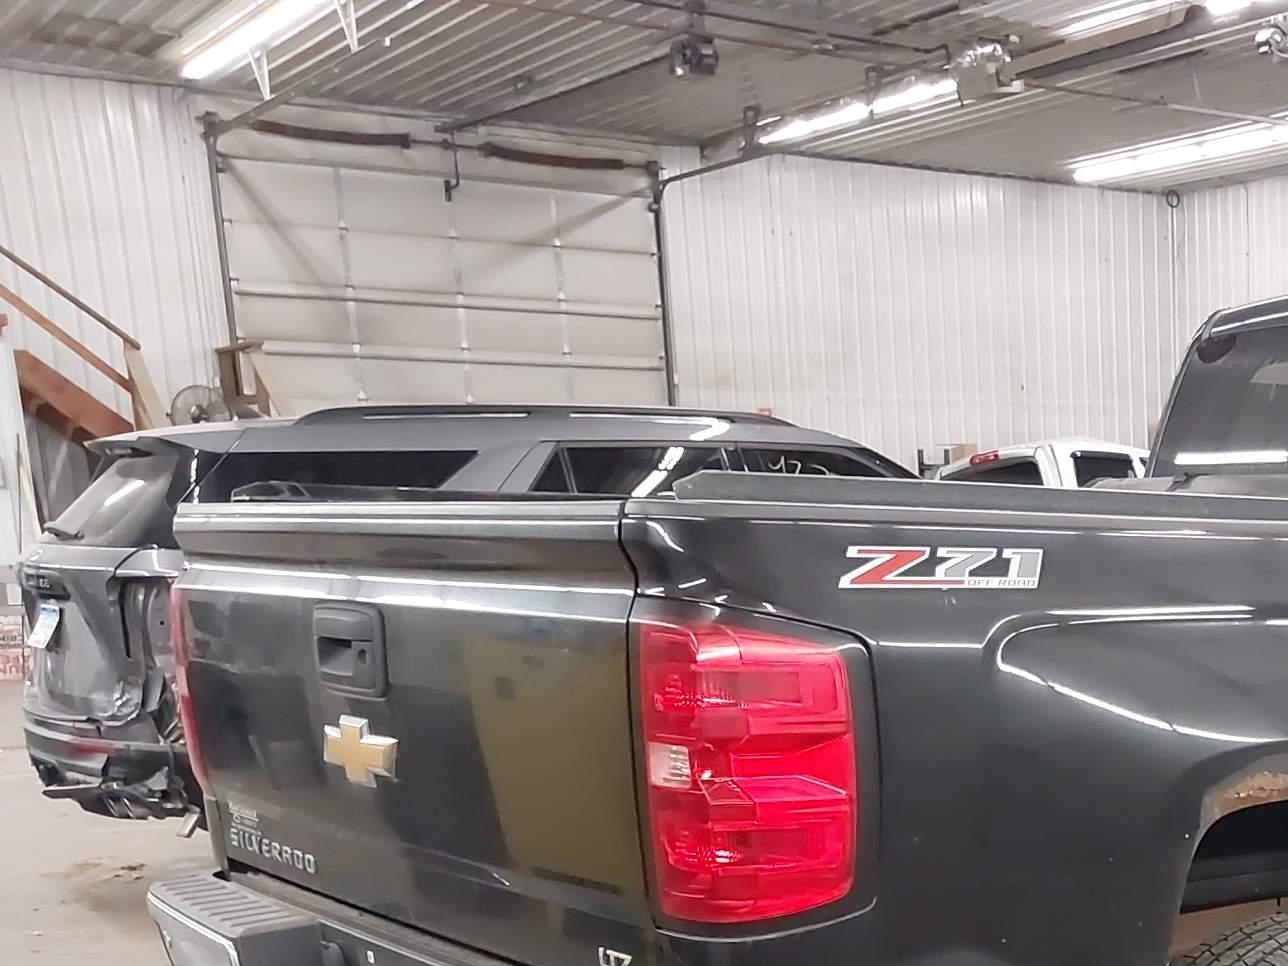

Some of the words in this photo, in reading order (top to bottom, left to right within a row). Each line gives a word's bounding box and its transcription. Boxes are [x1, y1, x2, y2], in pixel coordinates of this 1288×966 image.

[838, 545, 1043, 589] Z71
[966, 578, 996, 587] OFF
[998, 578, 1036, 587] ROAD
[229, 827, 317, 875] SILVERADO
